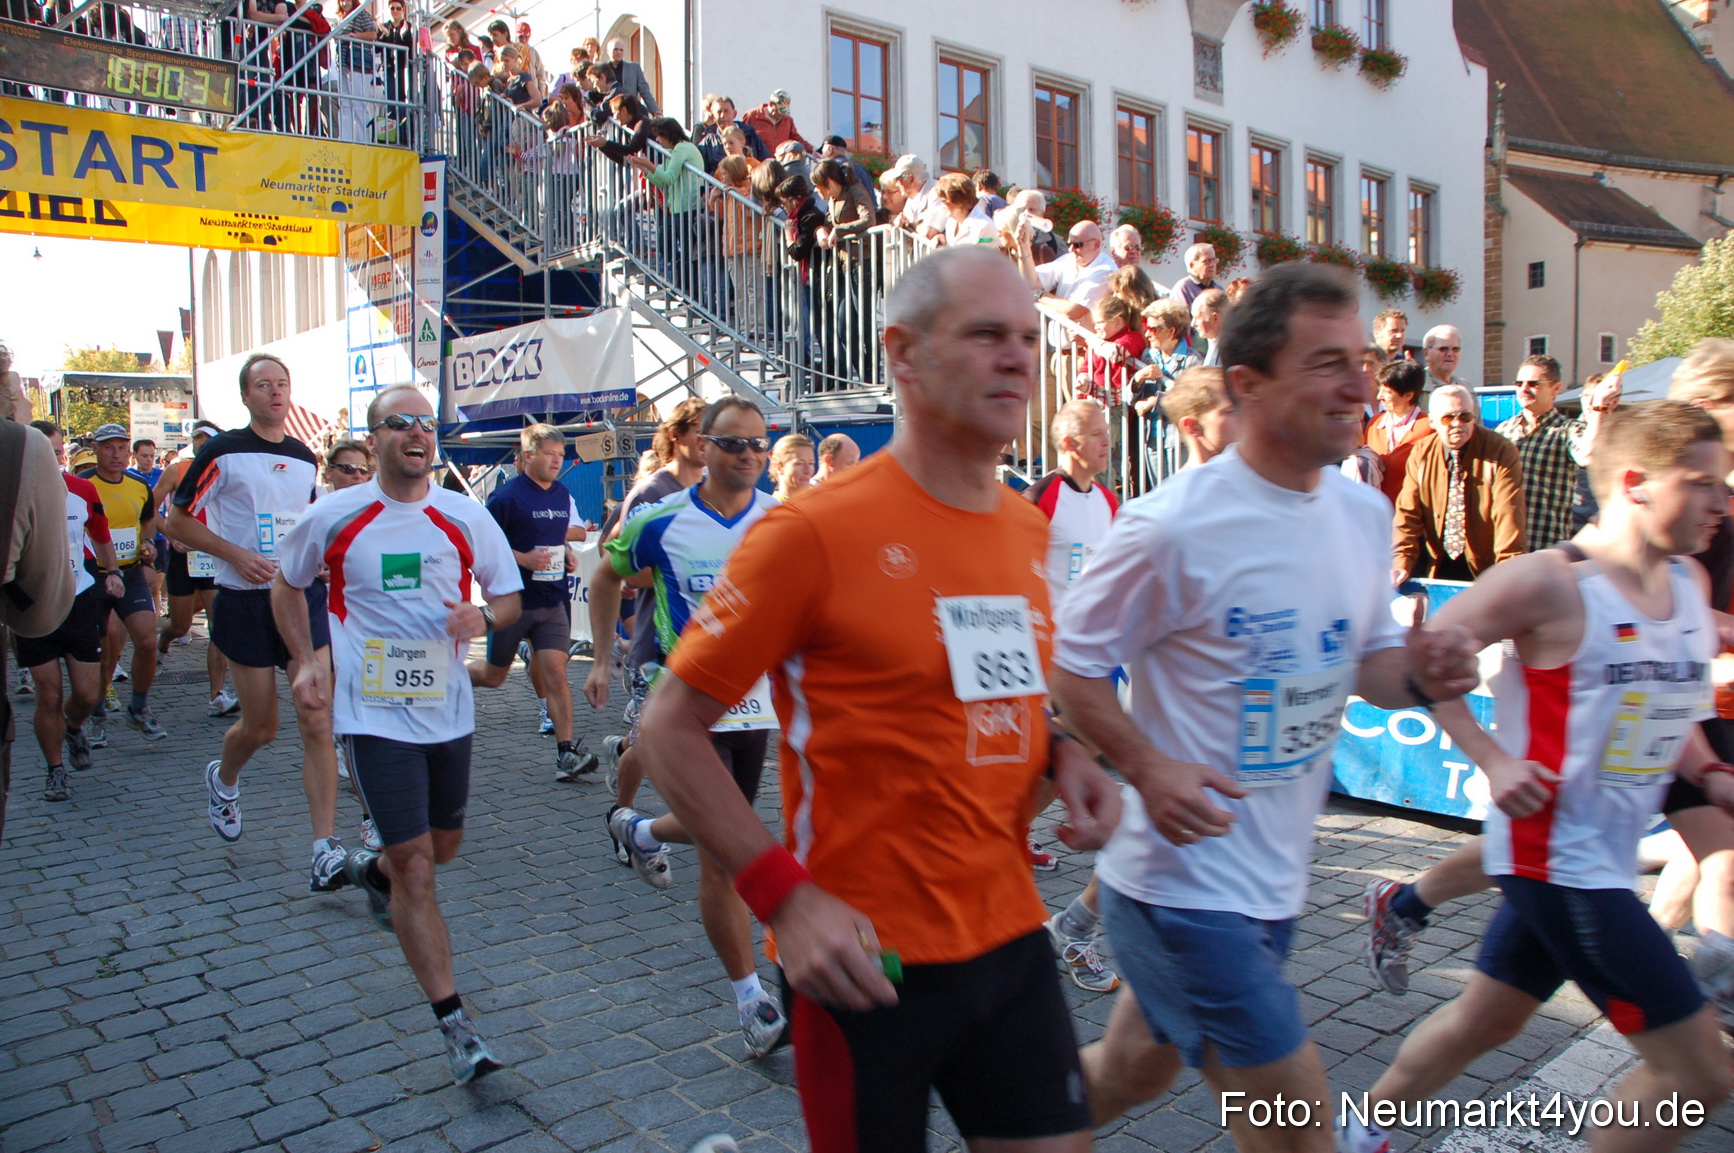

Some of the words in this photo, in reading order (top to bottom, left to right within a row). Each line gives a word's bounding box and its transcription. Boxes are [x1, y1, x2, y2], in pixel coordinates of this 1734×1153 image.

[63, 36, 123, 56] Elektronische
[260, 177, 332, 195] Neumarkter
[335, 184, 388, 200] Stadtlauf
[199, 216, 263, 231] Neumarkter
[265, 221, 313, 234] Stadtlauf
[453, 338, 544, 391] BOCK
[114, 540, 135, 551] 1068
[387, 645, 426, 661] Jürgen
[395, 669, 434, 687] 955
